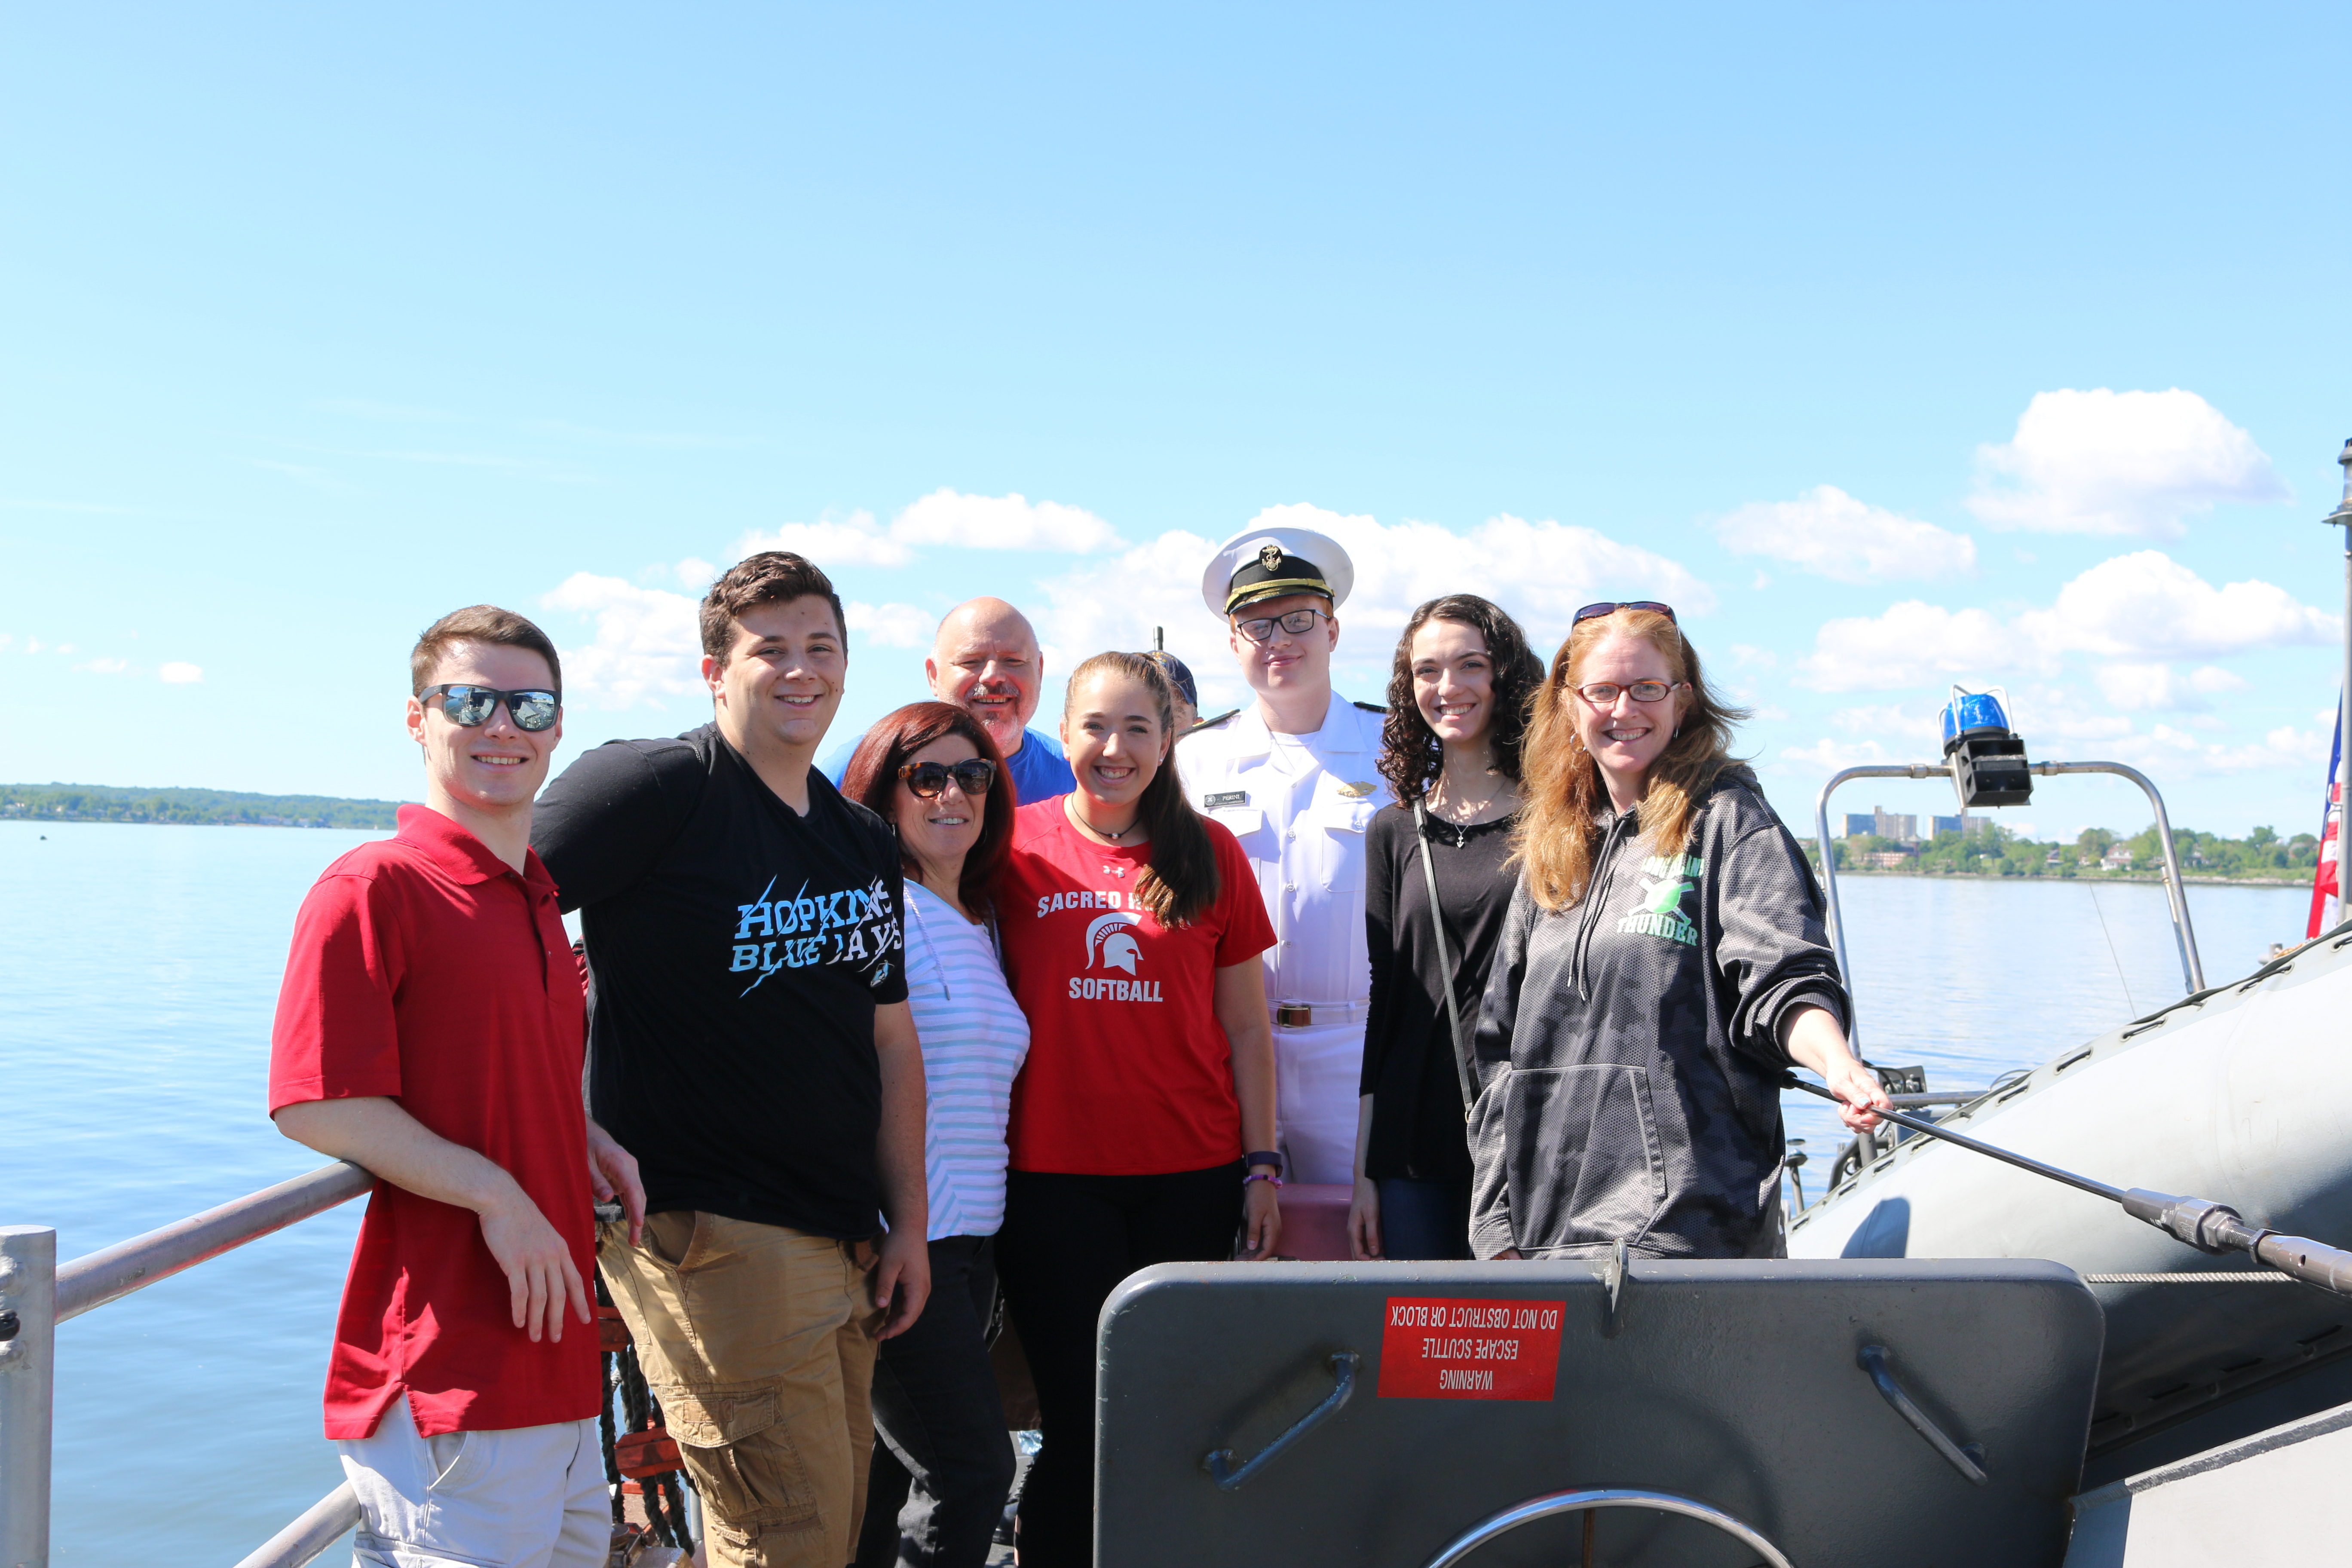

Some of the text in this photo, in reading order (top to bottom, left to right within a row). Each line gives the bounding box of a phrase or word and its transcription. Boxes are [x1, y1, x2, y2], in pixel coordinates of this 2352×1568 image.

[1640, 855, 1671, 879] LONG
[735, 876, 892, 939] HOPKINS
[1037, 891, 1121, 918] SACRED
[1616, 913, 1698, 946] THUNDER
[729, 916, 902, 974] BLUE JAYS
[1069, 977, 1163, 1002] SOFTBALL
[1390, 1306, 1558, 1329] DO NOT OBSTRUCT OR BLOCK
[1421, 1338, 1519, 1360] ESCAPE SCUTTLE
[1439, 1369, 1493, 1390] WARNING
